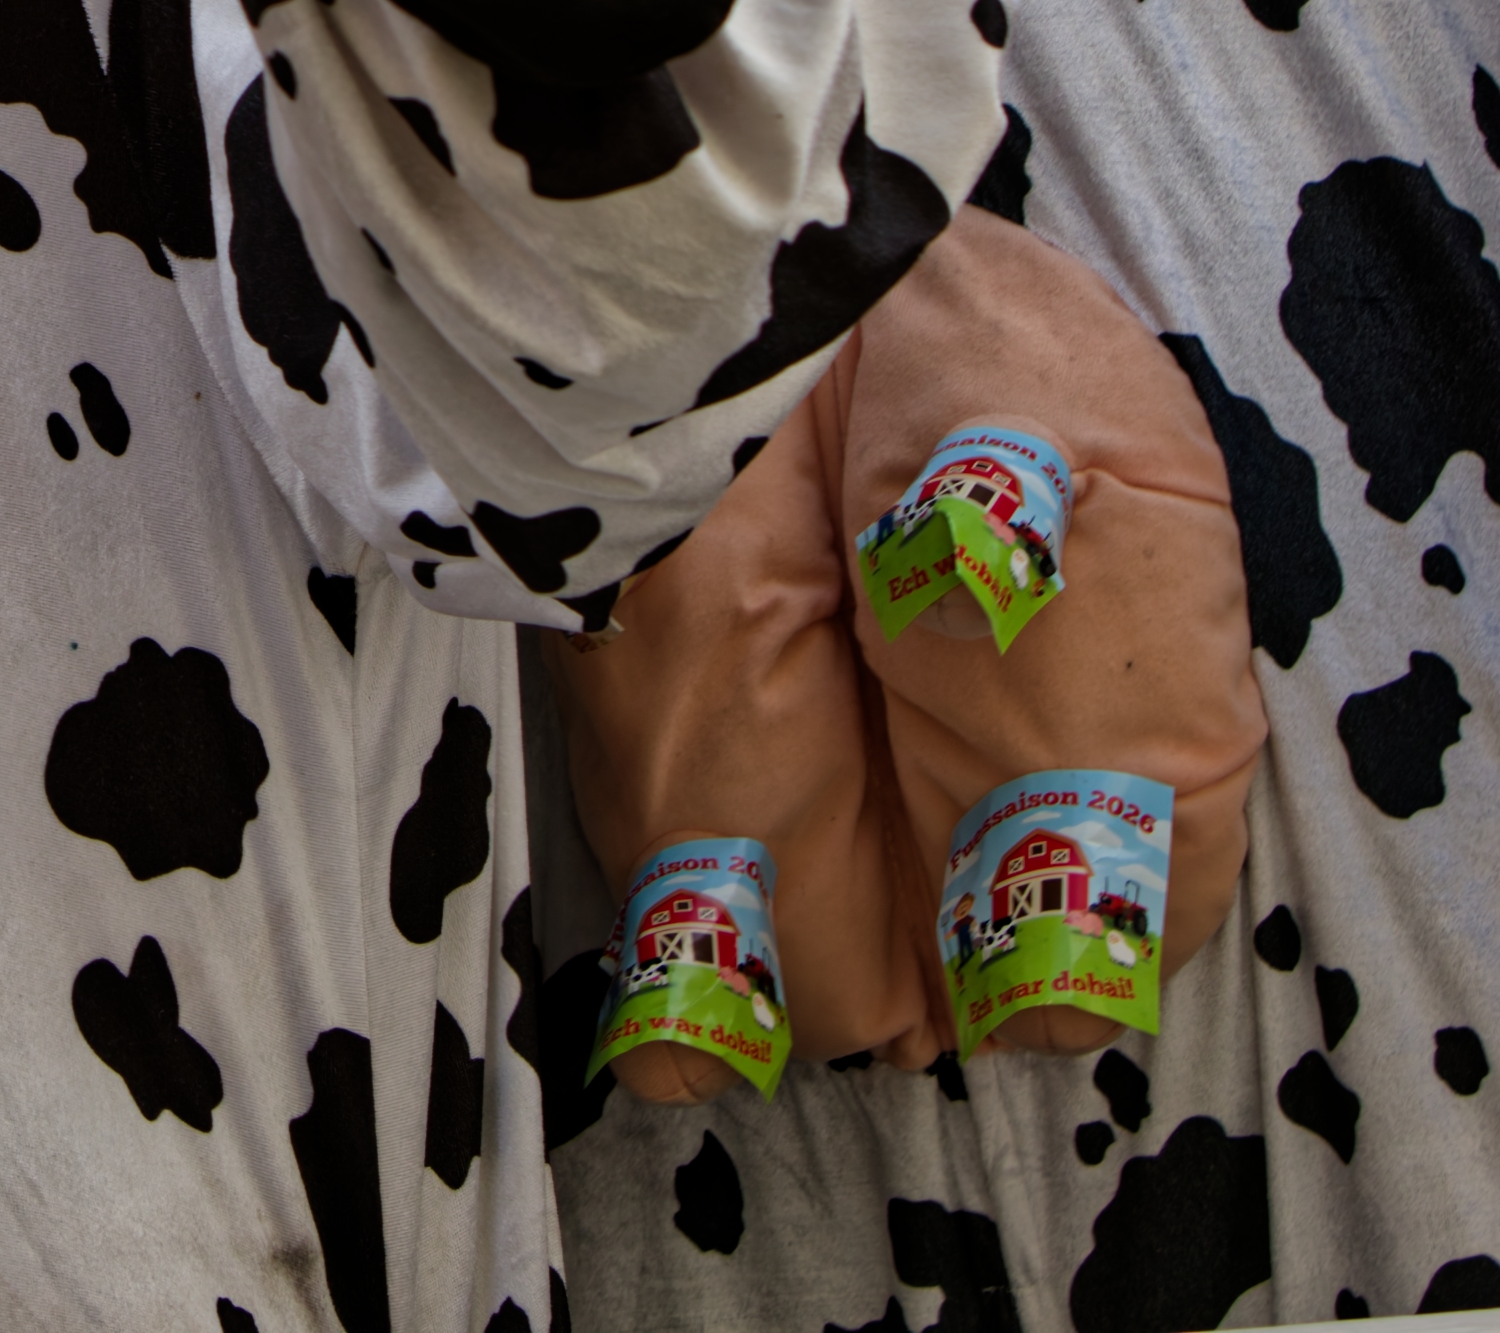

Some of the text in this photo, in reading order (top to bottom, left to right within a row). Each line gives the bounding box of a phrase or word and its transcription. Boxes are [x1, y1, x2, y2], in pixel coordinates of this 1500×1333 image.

[1086, 789, 1157, 835] 2026
[998, 978, 1046, 1007] war
[648, 1016, 704, 1038] war
